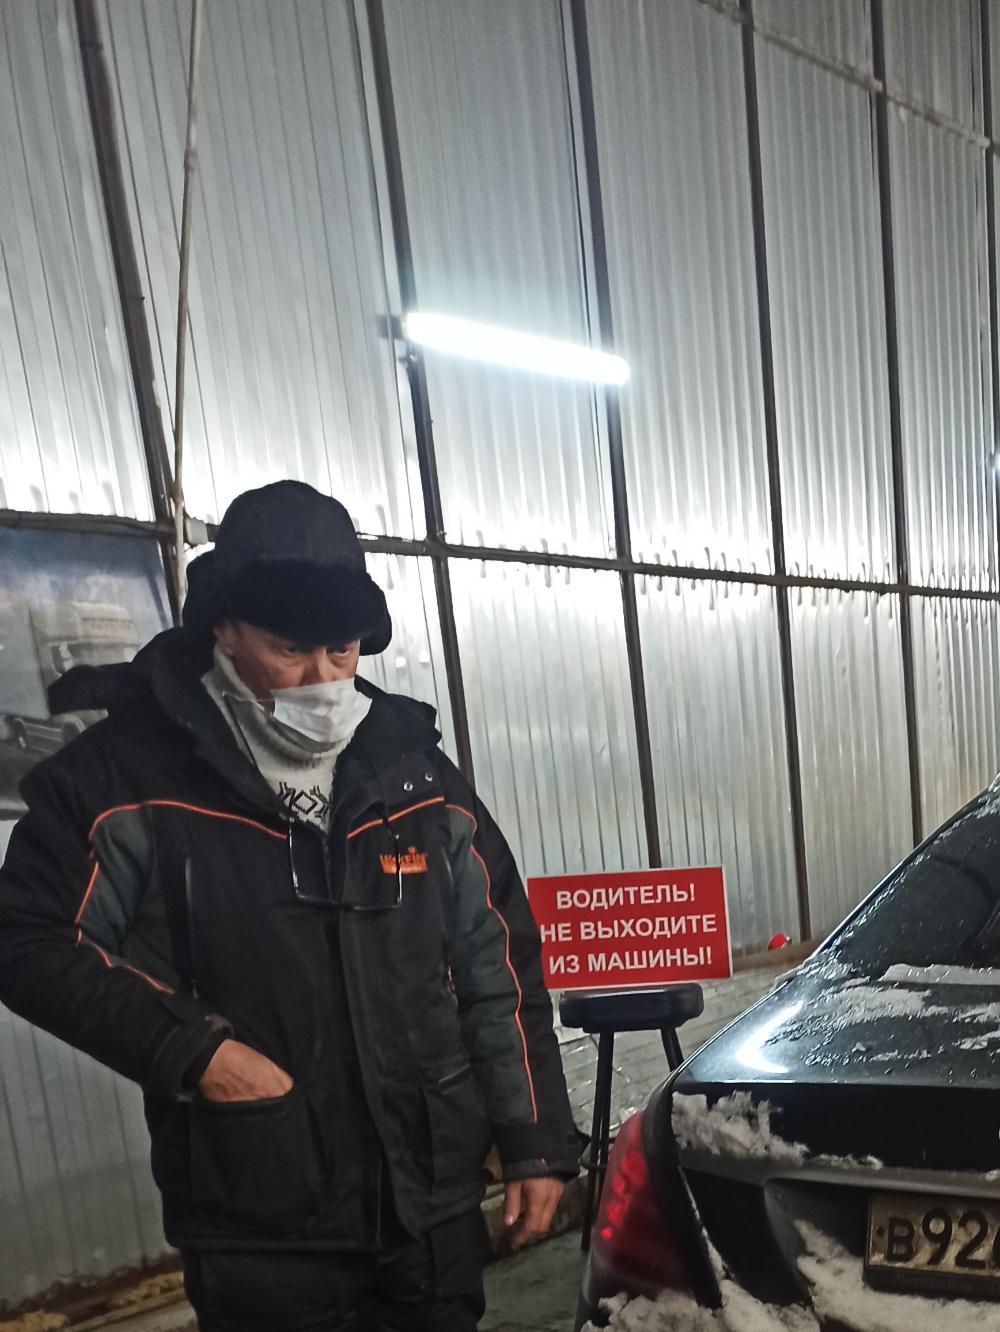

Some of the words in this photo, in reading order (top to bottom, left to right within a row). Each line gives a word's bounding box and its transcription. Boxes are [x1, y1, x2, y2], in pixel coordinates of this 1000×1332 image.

[556, 883, 695, 911] ВОДИТЕЛЬ!
[540, 922, 573, 943] НЕ
[580, 914, 718, 940] ВЫХОДИТЕ
[549, 955, 580, 975] ИЗ
[588, 946, 712, 972] МАШИНЫ!
